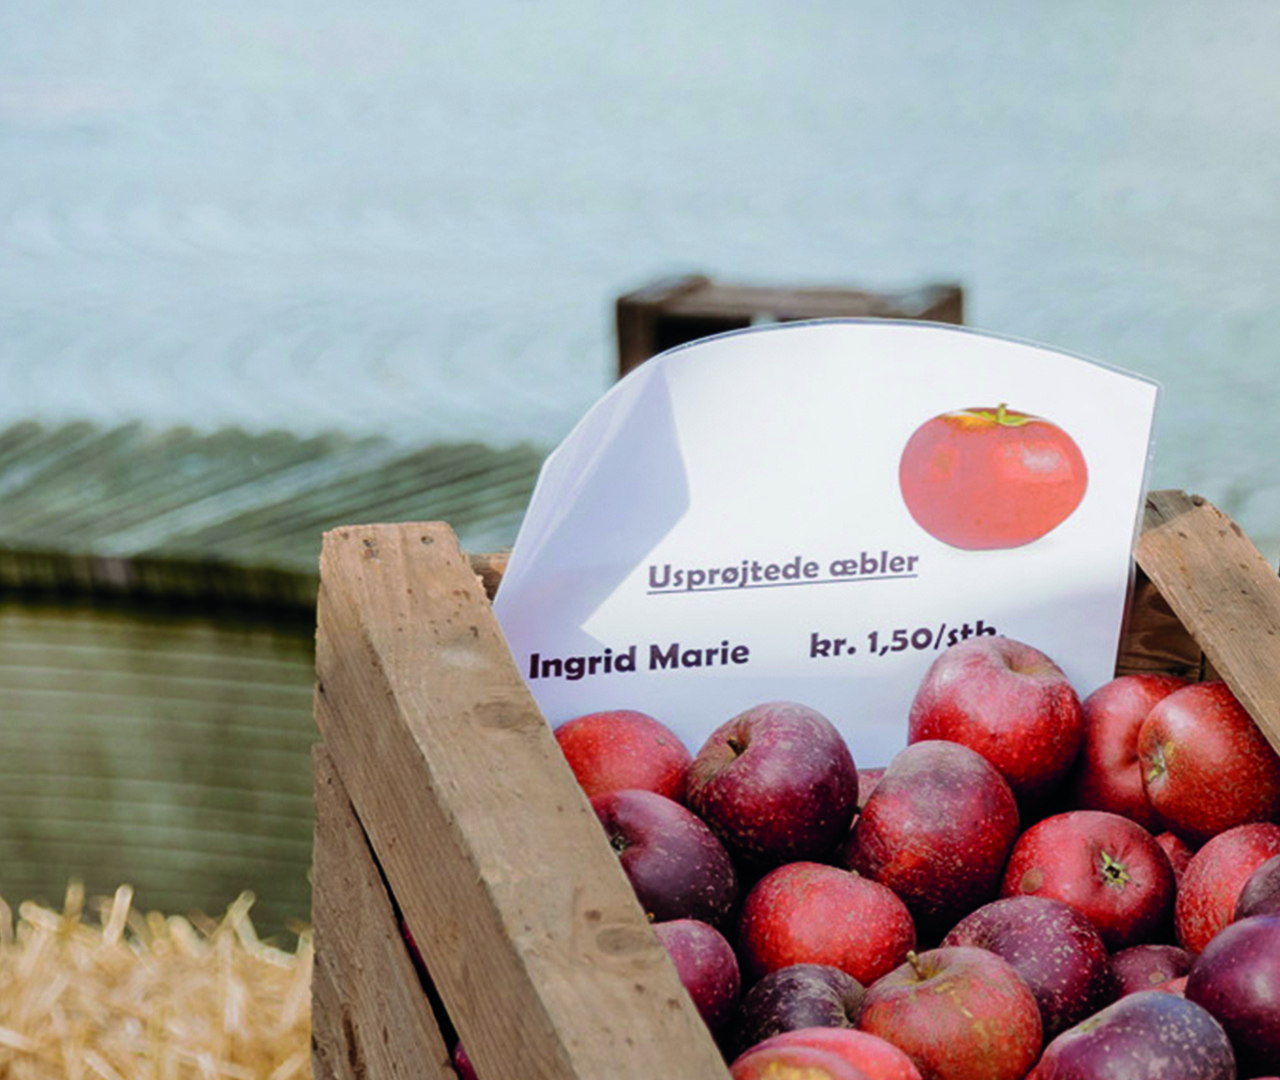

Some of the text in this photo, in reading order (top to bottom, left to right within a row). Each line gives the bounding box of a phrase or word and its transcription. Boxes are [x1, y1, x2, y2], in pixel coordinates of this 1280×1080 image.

[648, 550, 919, 591] Usprøjtede æbler
[529, 645, 636, 681] Ingrid
[649, 640, 750, 671] Marie
[810, 632, 857, 658] kr.
